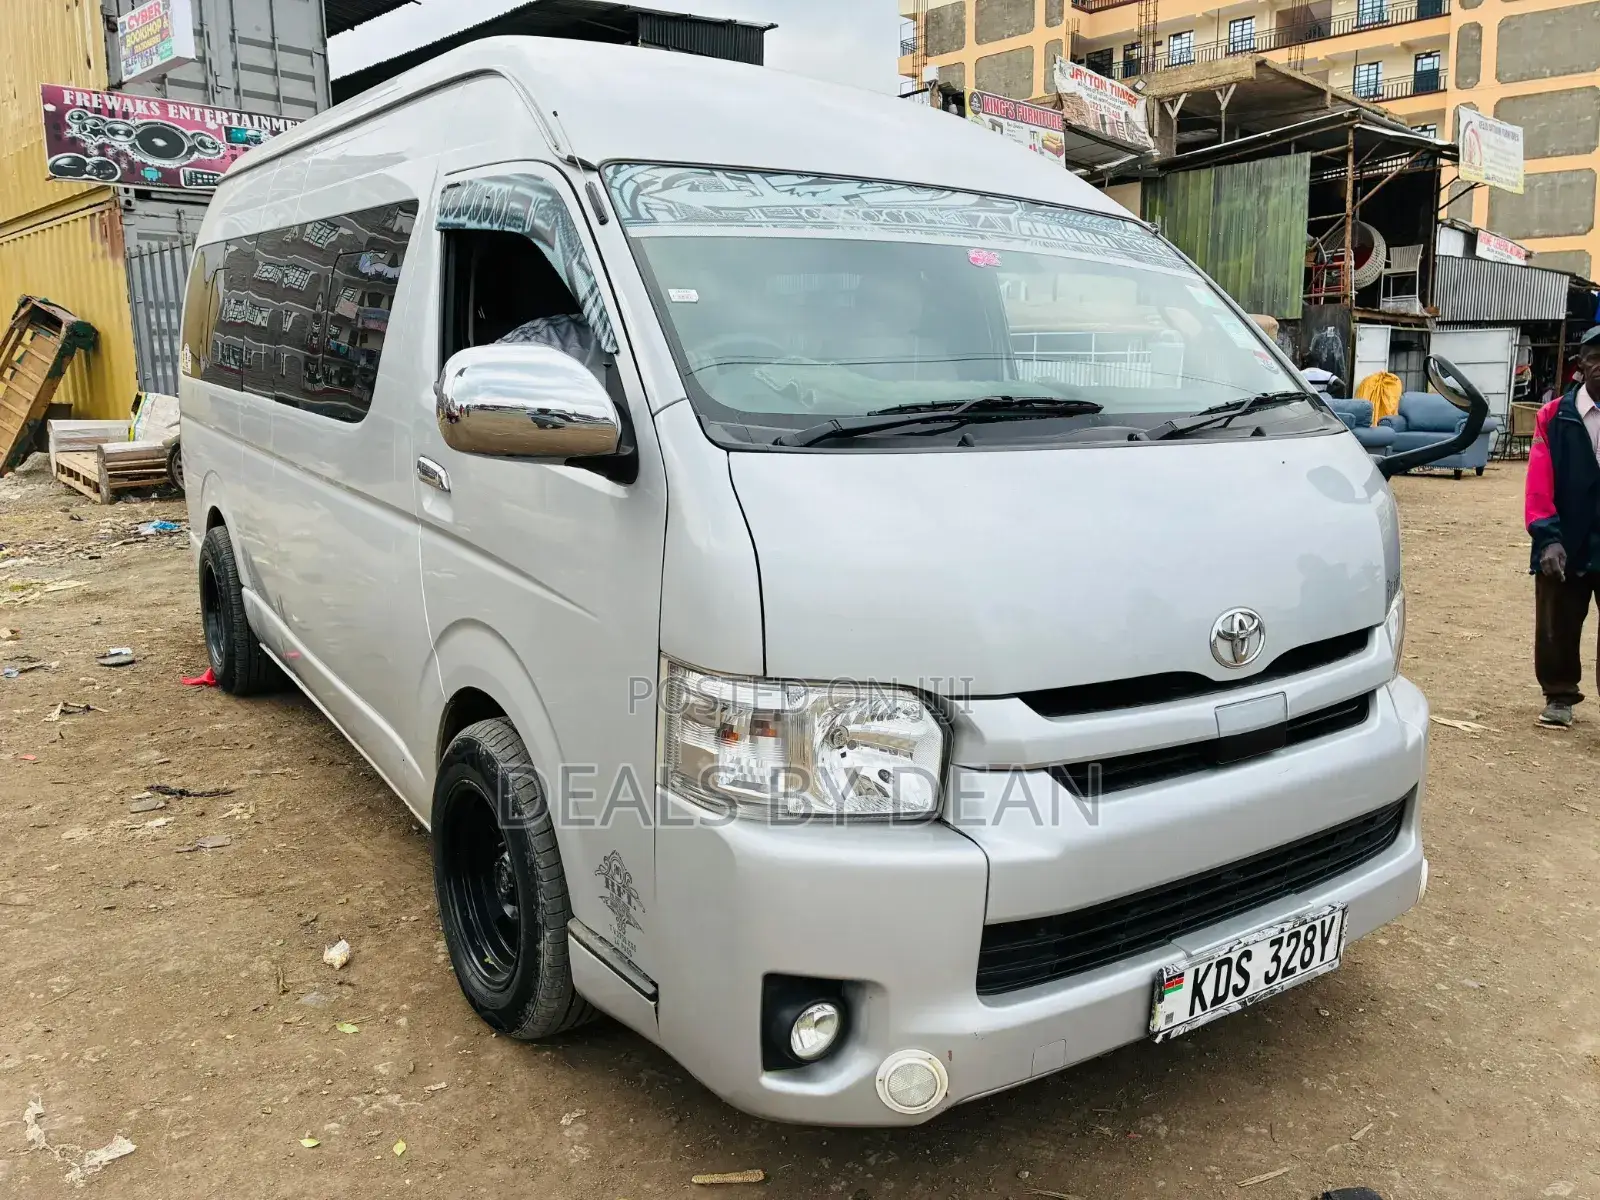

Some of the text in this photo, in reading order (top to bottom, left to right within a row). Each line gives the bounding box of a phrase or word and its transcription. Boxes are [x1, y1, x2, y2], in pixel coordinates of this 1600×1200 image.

[128, 1, 161, 30] CYBER
[125, 17, 162, 48] BOOKSHOP
[1070, 66, 1107, 91] JAYTON
[62, 89, 161, 116] FREWAKS
[983, 95, 1015, 119] KING'S
[1016, 103, 1063, 129] FURNITURE
[1188, 915, 1336, 1017] KDS 328Y
